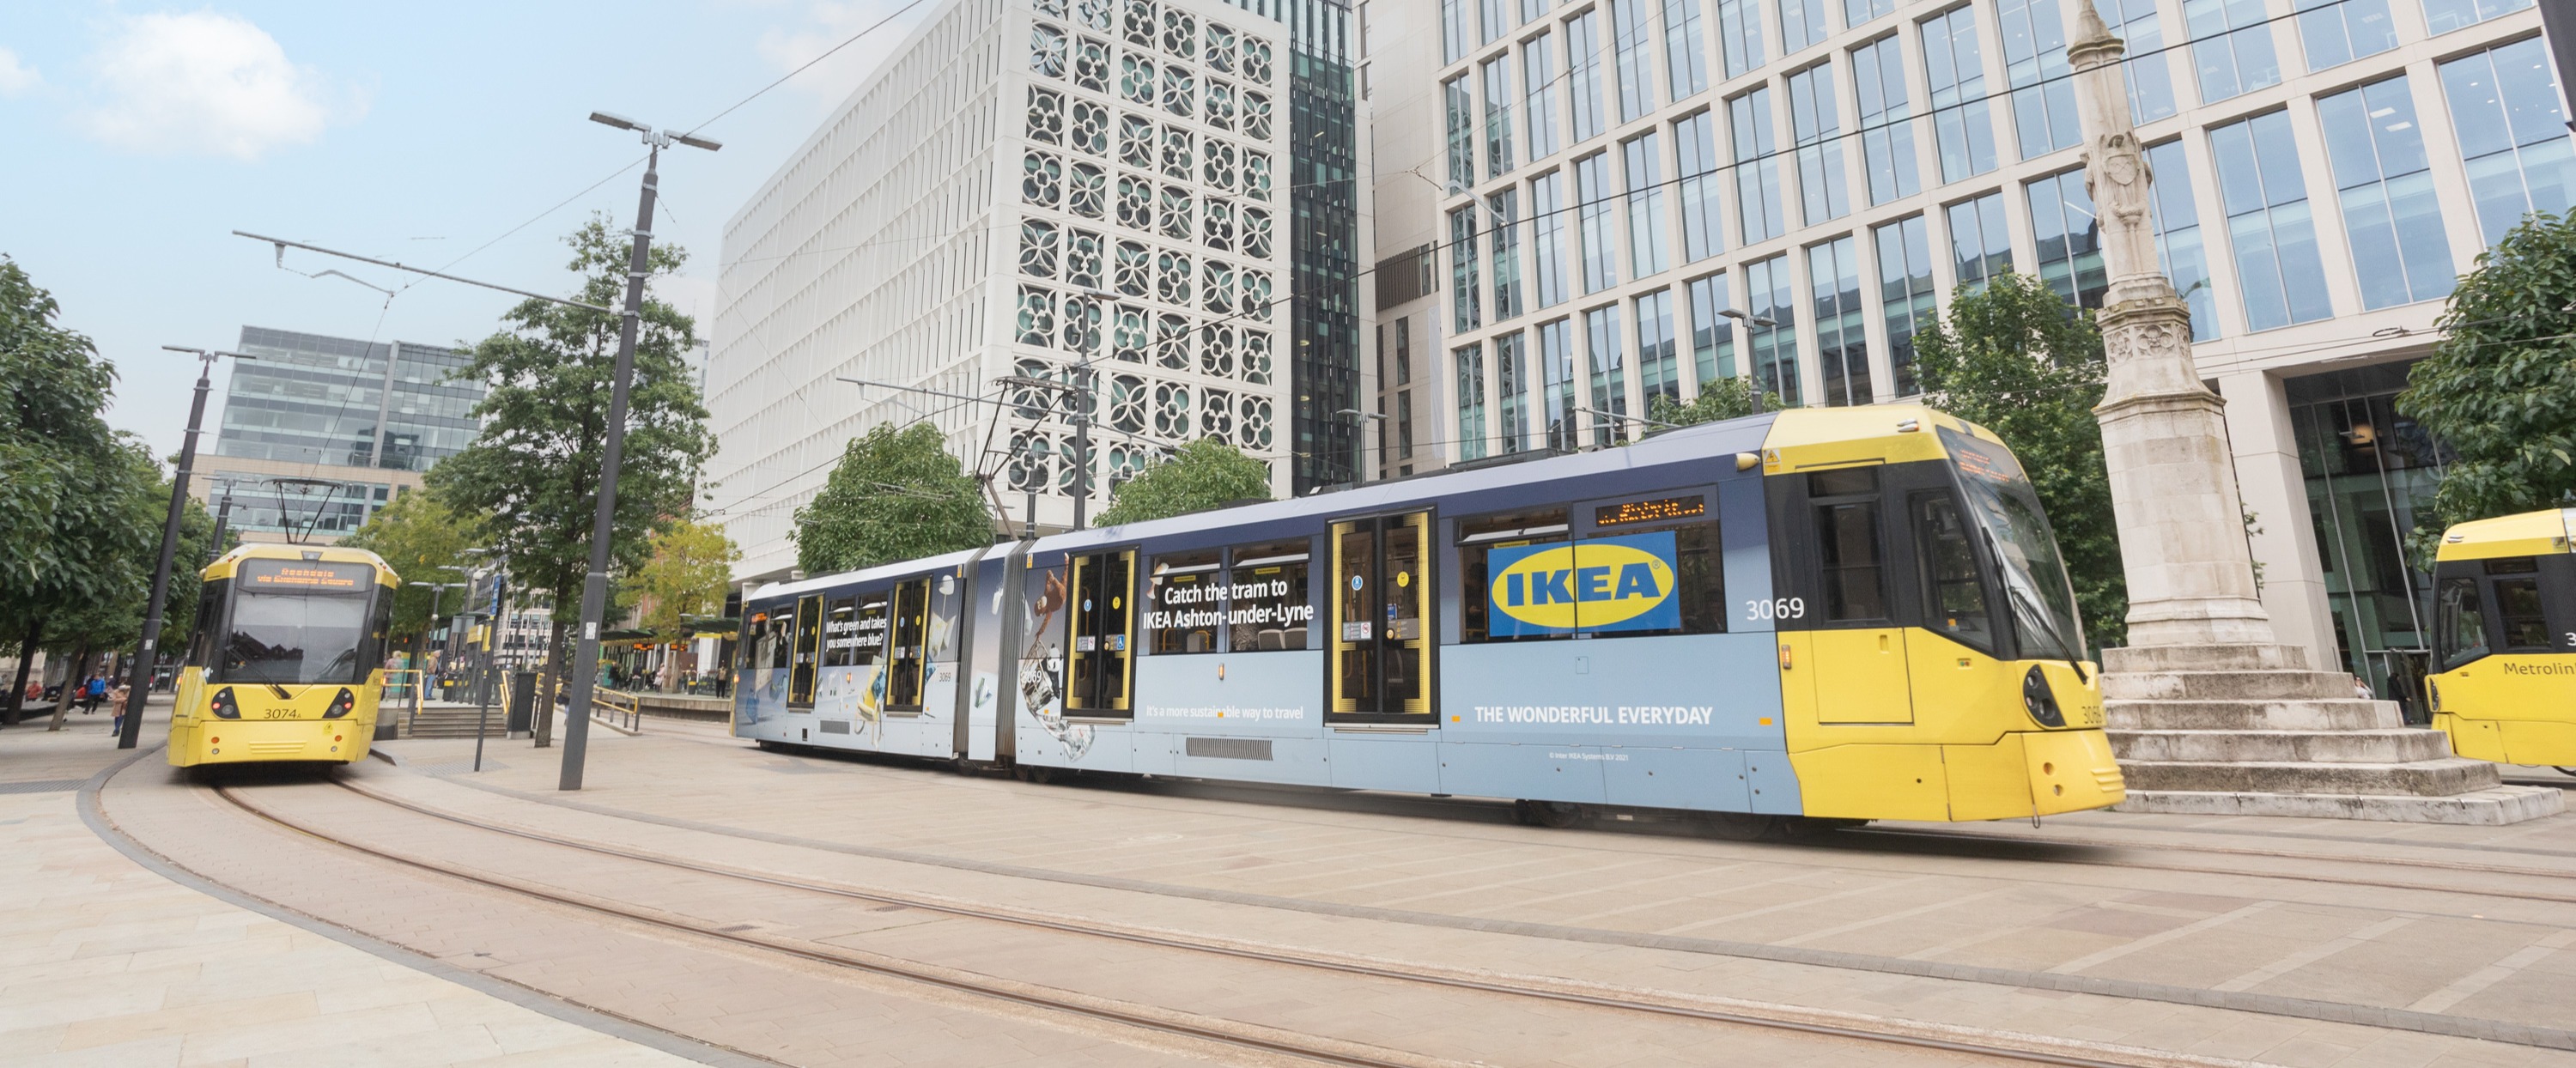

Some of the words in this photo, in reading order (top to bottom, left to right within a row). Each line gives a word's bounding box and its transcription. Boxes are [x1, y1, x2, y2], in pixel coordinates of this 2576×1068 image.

[1165, 585, 1202, 604] Catch
[1205, 583, 1228, 602] the
[1231, 581, 1268, 600] tram
[1271, 580, 1288, 597] to
[1507, 562, 1662, 607] IKEA
[1746, 597, 1805, 621] 3069
[826, 621, 843, 634] What's
[843, 621, 860, 635] green
[860, 616, 871, 630] and
[871, 616, 887, 628] takes
[1143, 610, 1172, 629] IKEA
[826, 638, 836, 652] you
[836, 634, 867, 648] somewhere
[867, 633, 884, 646] blue?
[2504, 661, 2576, 676] Metrolin
[1146, 705, 1158, 717] It's
[1166, 707, 1188, 717] more
[1242, 708, 1261, 722] way
[1263, 707, 1273, 719] to
[1275, 706, 1303, 719] travel
[1474, 706, 1504, 722] THE
[1507, 706, 1613, 724] WONDERFUL
[1619, 707, 1713, 725] EVERYDAY
[1582, 753, 1605, 762] Systems
